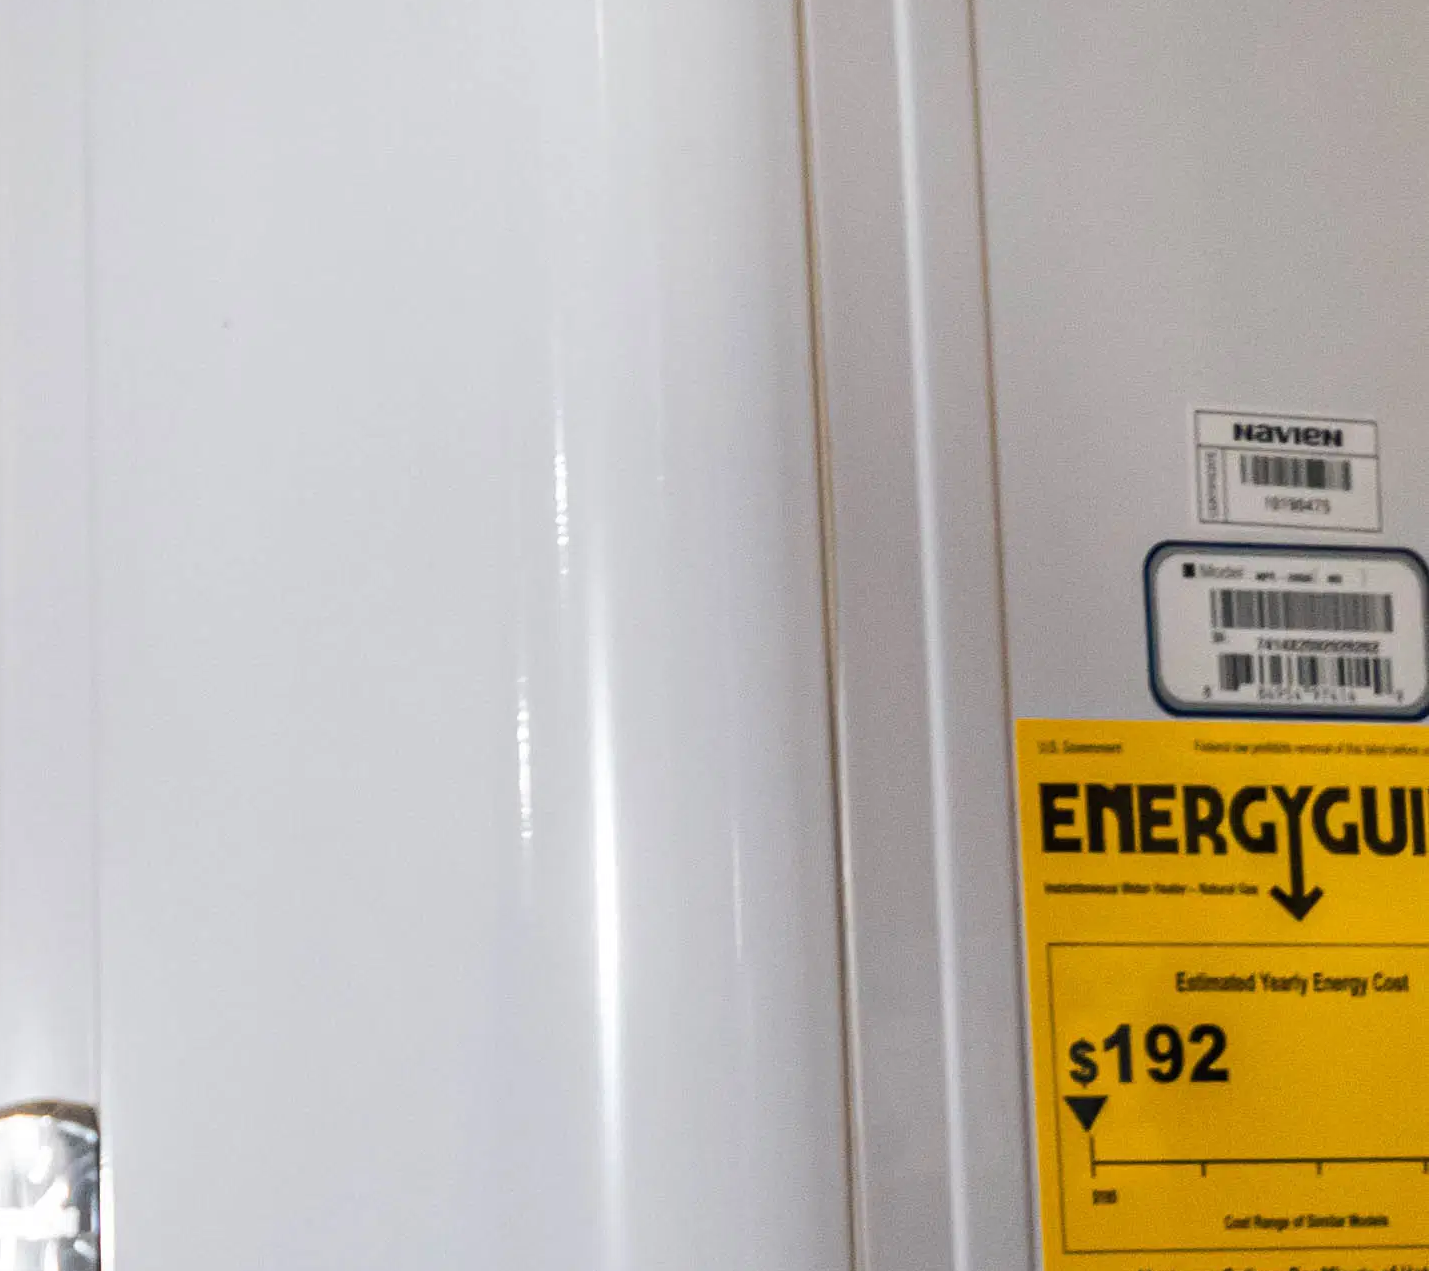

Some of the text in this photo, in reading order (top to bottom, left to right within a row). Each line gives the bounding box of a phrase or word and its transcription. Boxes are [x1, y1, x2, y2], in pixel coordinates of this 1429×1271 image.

[1039, 781, 1429, 858] ENERGYGUI
[1175, 971, 1409, 997] Estimated Yearly Energy Cost
[1068, 1023, 1230, 1088] $192
